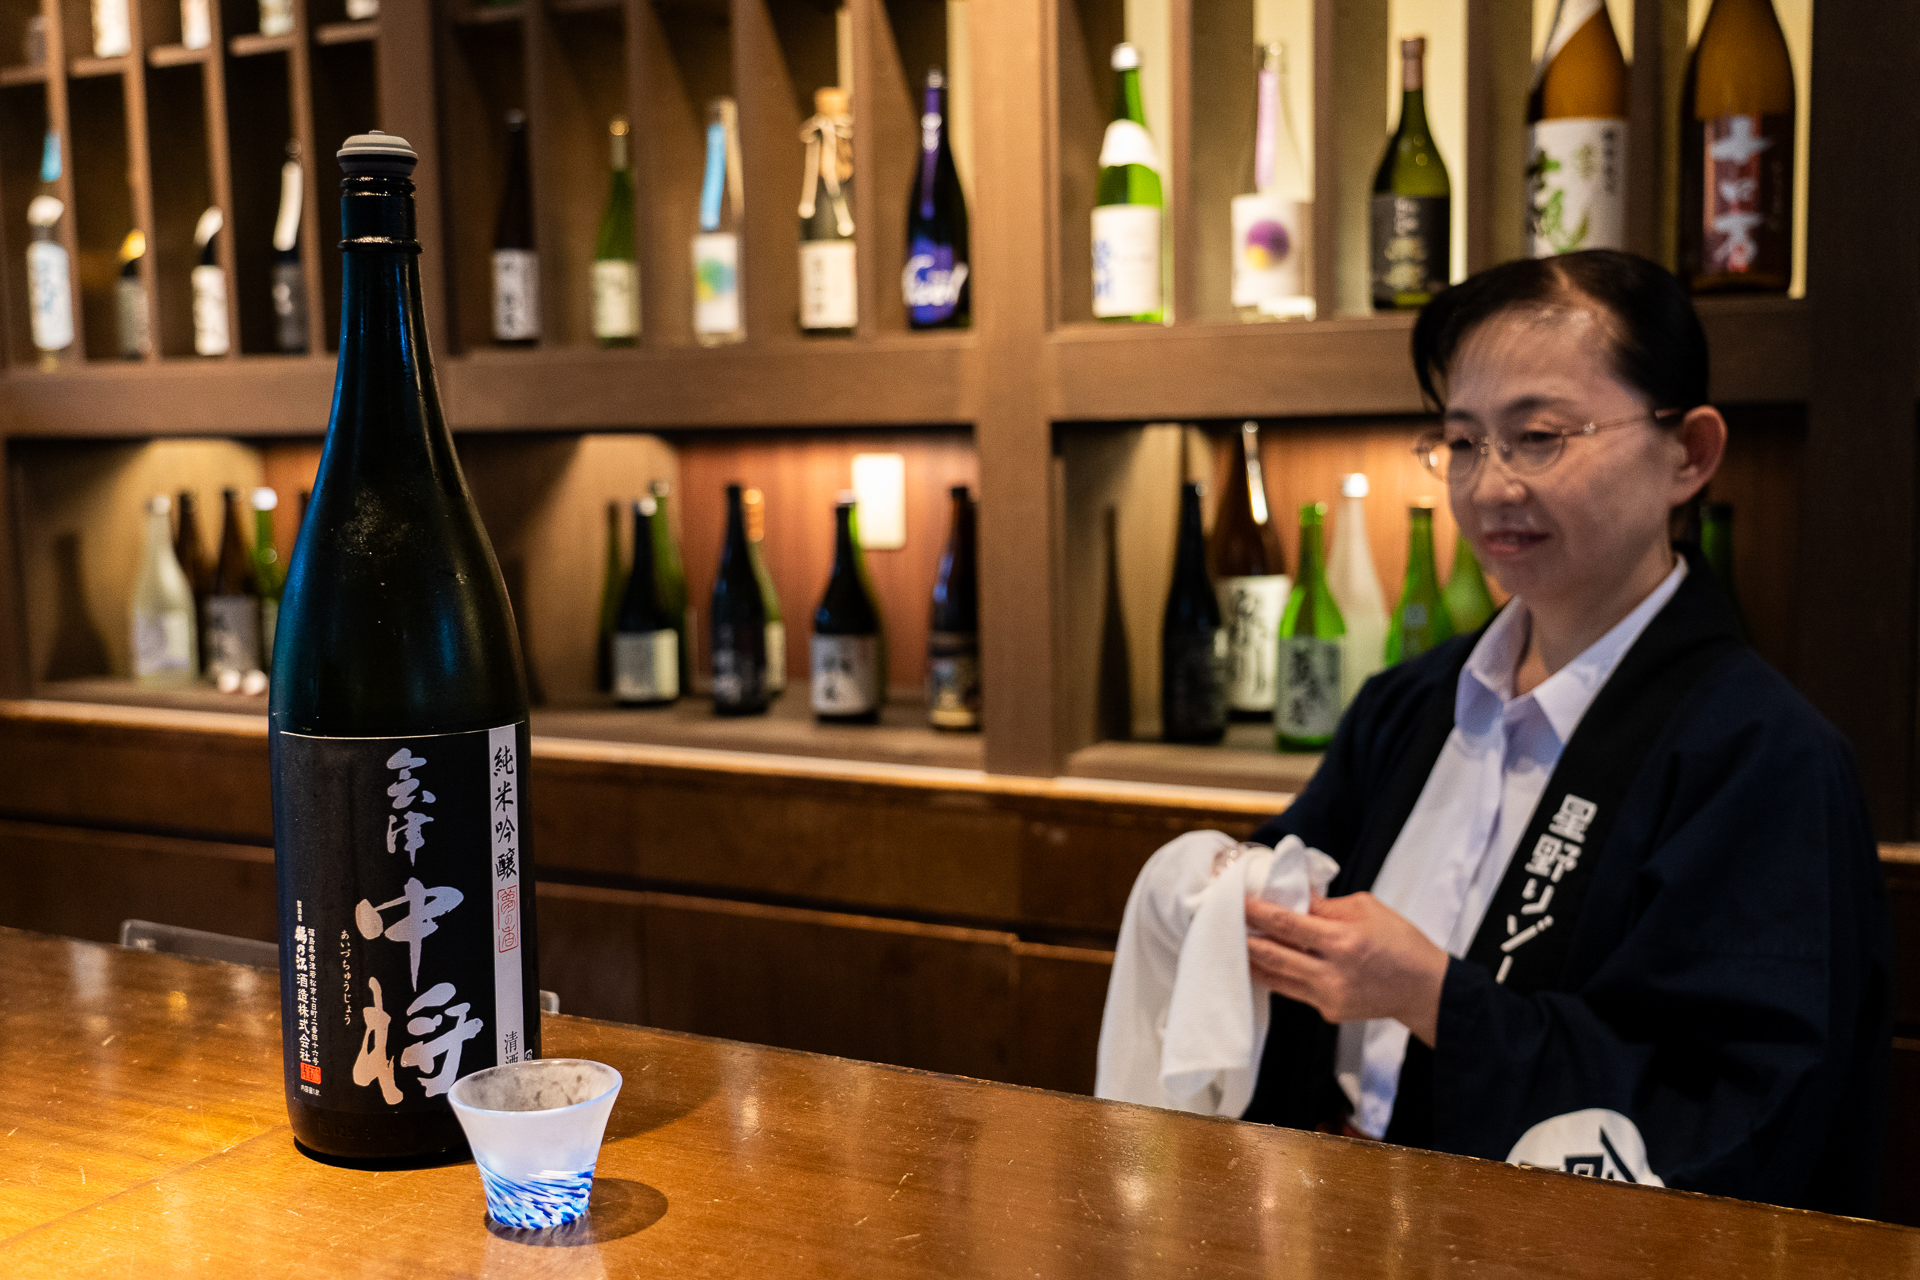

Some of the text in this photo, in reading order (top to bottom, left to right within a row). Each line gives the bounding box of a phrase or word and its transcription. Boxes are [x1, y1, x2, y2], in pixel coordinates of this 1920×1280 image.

[493, 744, 518, 882] 純米吟醸
[340, 929, 353, 1026] あいづちゅうじょう
